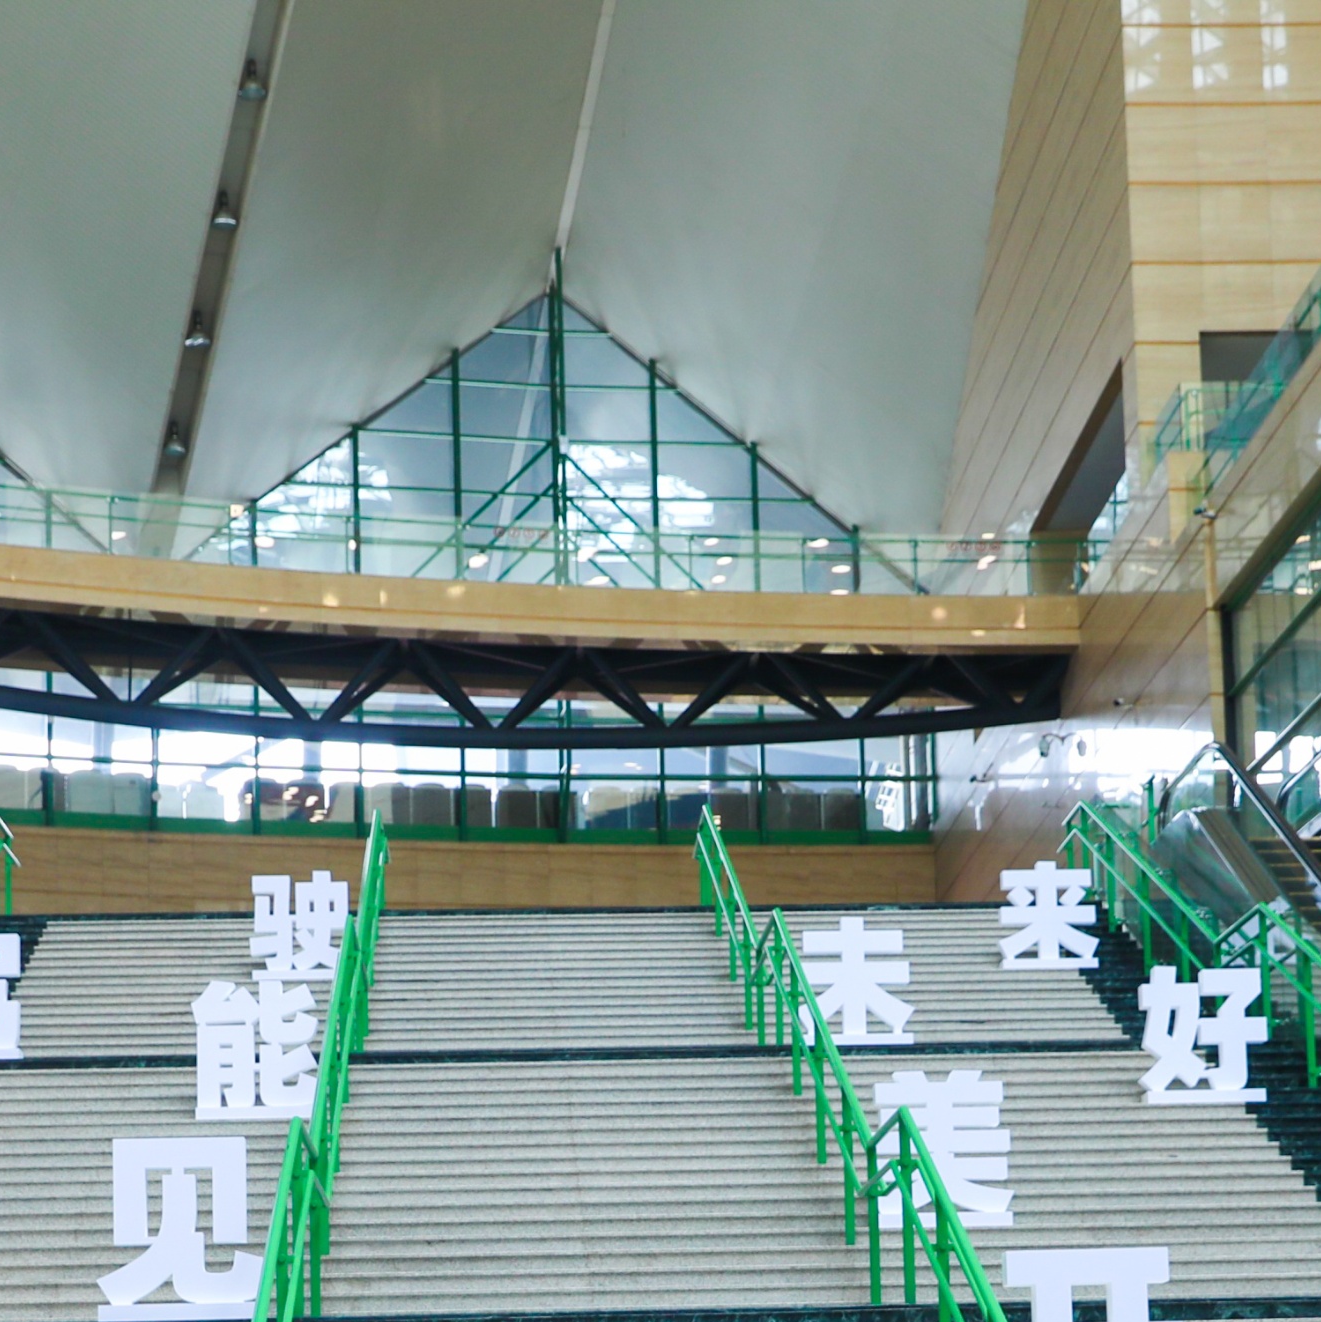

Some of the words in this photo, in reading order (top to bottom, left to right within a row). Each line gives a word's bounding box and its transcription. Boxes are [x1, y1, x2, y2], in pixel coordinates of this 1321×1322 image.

[249, 870, 348, 971] 驶
[999, 861, 1100, 961] 来
[799, 917, 915, 1036] 未
[1138, 966, 1268, 1091] 好
[190, 980, 318, 1108] 能
[872, 1069, 1015, 1213] 美
[96, 1137, 264, 1306] 见
